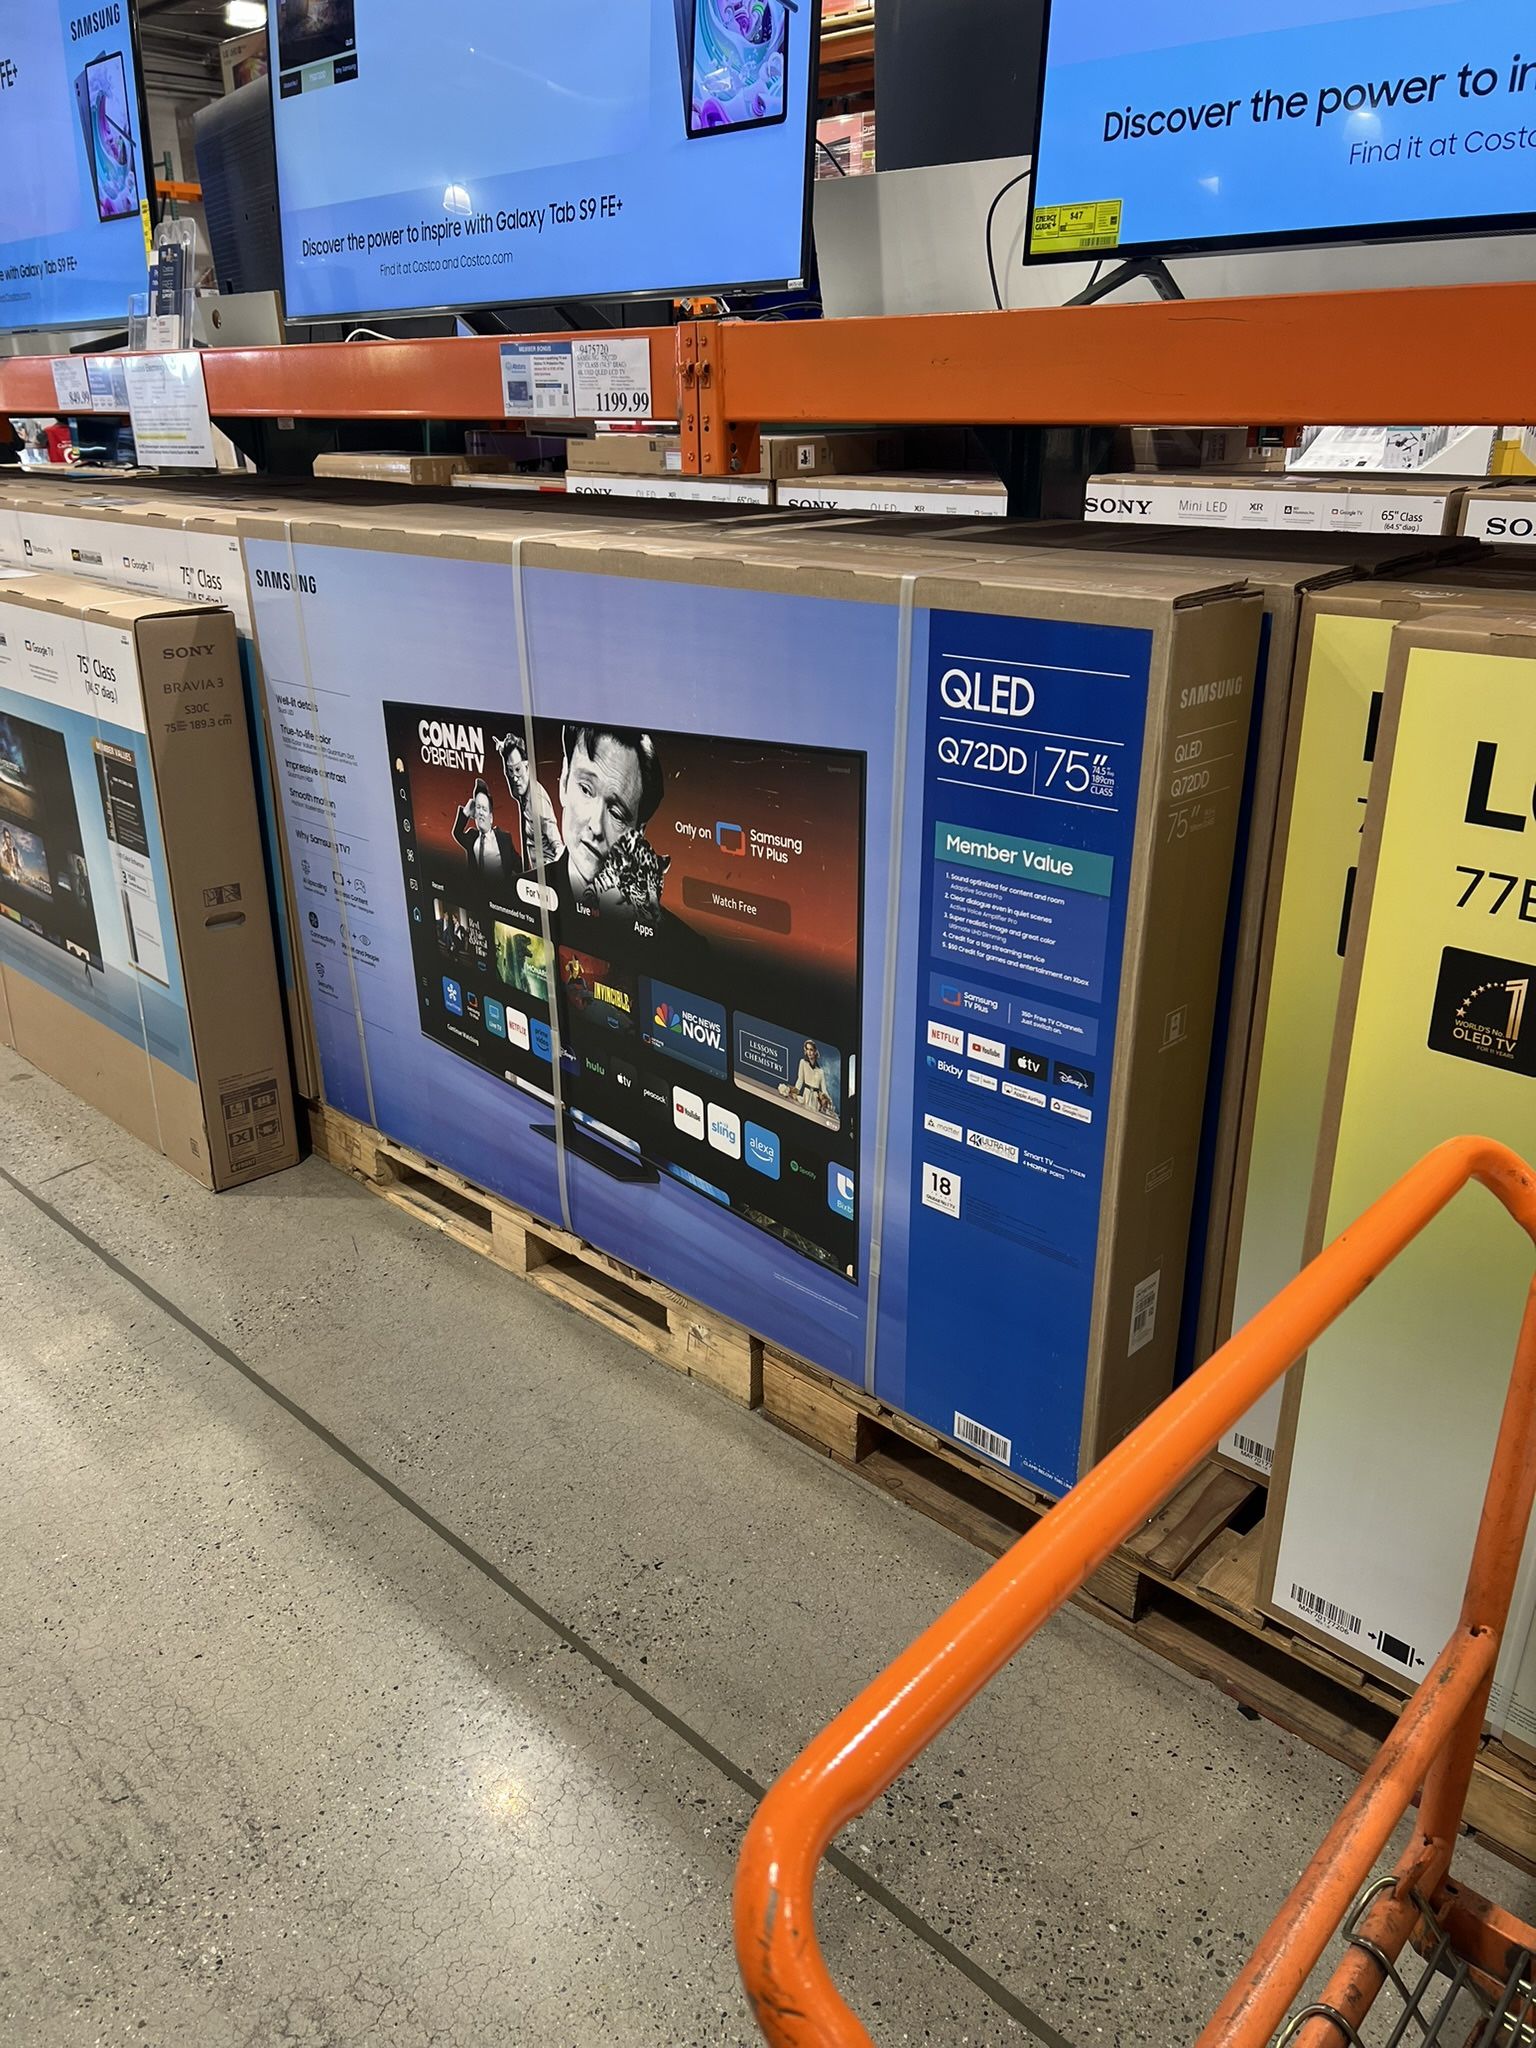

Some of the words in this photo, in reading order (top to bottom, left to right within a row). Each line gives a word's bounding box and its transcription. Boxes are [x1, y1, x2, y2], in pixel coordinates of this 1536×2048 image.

[70, 3, 120, 41] SAMSUNG
[1103, 97, 1240, 142] Discover
[1250, 88, 1308, 123] the
[1316, 71, 1446, 126] power
[1458, 62, 1498, 98] to
[1349, 138, 1400, 165] Find
[1407, 134, 1421, 159] it
[1429, 132, 1458, 157] at
[302, 238, 344, 257] Discover
[347, 232, 365, 251] the
[367, 227, 403, 254] power
[407, 226, 419, 244] to
[420, 217, 461, 246] inspire
[464, 212, 493, 235] with
[496, 206, 546, 234] Galaxy
[549, 201, 576, 225] Tab
[579, 197, 596, 220] S9
[600, 193, 623, 218] FE+
[1070, 211, 1083, 220] $47
[412, 258, 441, 274] Costco
[442, 256, 459, 271] and
[460, 250, 513, 269] Costco.com
[579, 344, 609, 355] 9475720
[596, 392, 649, 413] 1199.99
[1084, 497, 1152, 515] SONY
[1179, 499, 1202, 512] Mini
[1205, 501, 1228, 513] LED
[1249, 502, 1263, 511] XR
[1339, 508, 1356, 517] Google
[1381, 510, 1399, 521] 65"
[1400, 512, 1423, 522] Class
[1486, 517, 1536, 536] SO
[179, 566, 195, 586] 75"
[197, 568, 223, 591] Class
[256, 569, 317, 594] SAMSUNG
[163, 644, 215, 659] SONY
[76, 654, 90, 674] 75"
[93, 658, 117, 682] Class
[163, 679, 216, 694] BRAVIA
[217, 678, 224, 688] 3
[940, 668, 1035, 717] QLED
[1180, 676, 1243, 709] SAMSUNG
[184, 703, 210, 714] S30C
[189, 718, 216, 730] 189.3
[418, 719, 485, 754] CONAN
[938, 737, 1028, 775] Q72DD
[1175, 740, 1202, 763] QLED
[285, 759, 318, 776] Impressive
[1091, 774, 1115, 786] 189cm
[1170, 771, 1210, 797] Q72DD
[289, 787, 313, 803] Smooth
[1090, 786, 1114, 797] CLASS
[675, 821, 697, 840] Only
[698, 827, 712, 840] on
[750, 829, 802, 855] Samsung
[750, 844, 764, 858] TV
[766, 848, 789, 864] Plus
[946, 834, 1019, 865] Member
[1022, 849, 1074, 877] Value
[122, 870, 127, 884] 3
[526, 886, 536, 898] For
[951, 873, 969, 884] Sound
[969, 877, 999, 890] optimized
[999, 884, 1009, 892] for
[1009, 886, 1033, 898] content
[1034, 891, 1047, 901] and
[1047, 896, 1065, 905] room
[576, 902, 591, 916] Live
[712, 893, 737, 910] Watch
[738, 900, 757, 915] Free
[950, 894, 965, 903] Clear
[966, 897, 991, 910] dialogue
[992, 904, 1007, 913] even
[1007, 906, 1014, 914] in
[1014, 908, 1029, 919] quiet
[1030, 913, 1053, 924] scenes
[634, 921, 654, 937] Apps
[949, 913, 965, 924] Super
[965, 918, 988, 930] realistic
[989, 922, 1008, 934] image
[1008, 927, 1021, 937] and
[1021, 931, 1039, 943] great
[1039, 936, 1056, 946] color
[948, 933, 966, 943] Credit
[966, 936, 975, 945] for
[981, 940, 991, 951] top
[992, 944, 1022, 959] streaming
[1023, 952, 1045, 964] service
[958, 945, 976, 956] Credit
[976, 950, 985, 958] for
[985, 954, 1006, 965] games
[1006, 958, 1019, 968] and
[1019, 962, 1063, 980] entertainment
[1063, 974, 1073, 982] on
[1072, 976, 1089, 986] Xbox
[593, 981, 631, 1014] INVINCIBLE
[963, 991, 999, 1010] Samsung
[964, 1000, 973, 1009] TV
[973, 1002, 989, 1014] Plus
[682, 1010, 698, 1024] NBC
[698, 1018, 721, 1033] NEWS
[1033, 1021, 1052, 1033] switch
[1034, 1013, 1048, 1024] Free
[509, 1021, 527, 1037] NETFLIX
[931, 1029, 960, 1046] NETFLIX
[1455, 1019, 1491, 1034] WORLD'S
[1492, 1029, 1505, 1038] No.
[750, 1040, 778, 1057] LESSONS
[1453, 1027, 1492, 1046] OLED
[1496, 1037, 1517, 1052] TV
[744, 1051, 784, 1073] CHEMISTRY
[982, 1046, 1000, 1059] YouTube
[1496, 1050, 1514, 1059] YEARS
[586, 1058, 605, 1075] hulu
[938, 1060, 963, 1079] Bixby
[643, 1088, 666, 1105] peacock
[711, 1119, 736, 1145] sling
[936, 1122, 960, 1136] matter
[750, 1136, 774, 1157] alexa
[969, 1133, 982, 1147] 4K
[981, 1137, 1005, 1151] ULTRA
[1005, 1146, 1016, 1156] HD
[1023, 1150, 1044, 1163] Smart
[1044, 1157, 1054, 1166] TV
[932, 1172, 951, 1197] 18
[1023, 1460, 1039, 1472] CLAMP
[1038, 1468, 1054, 1480] BELOW
